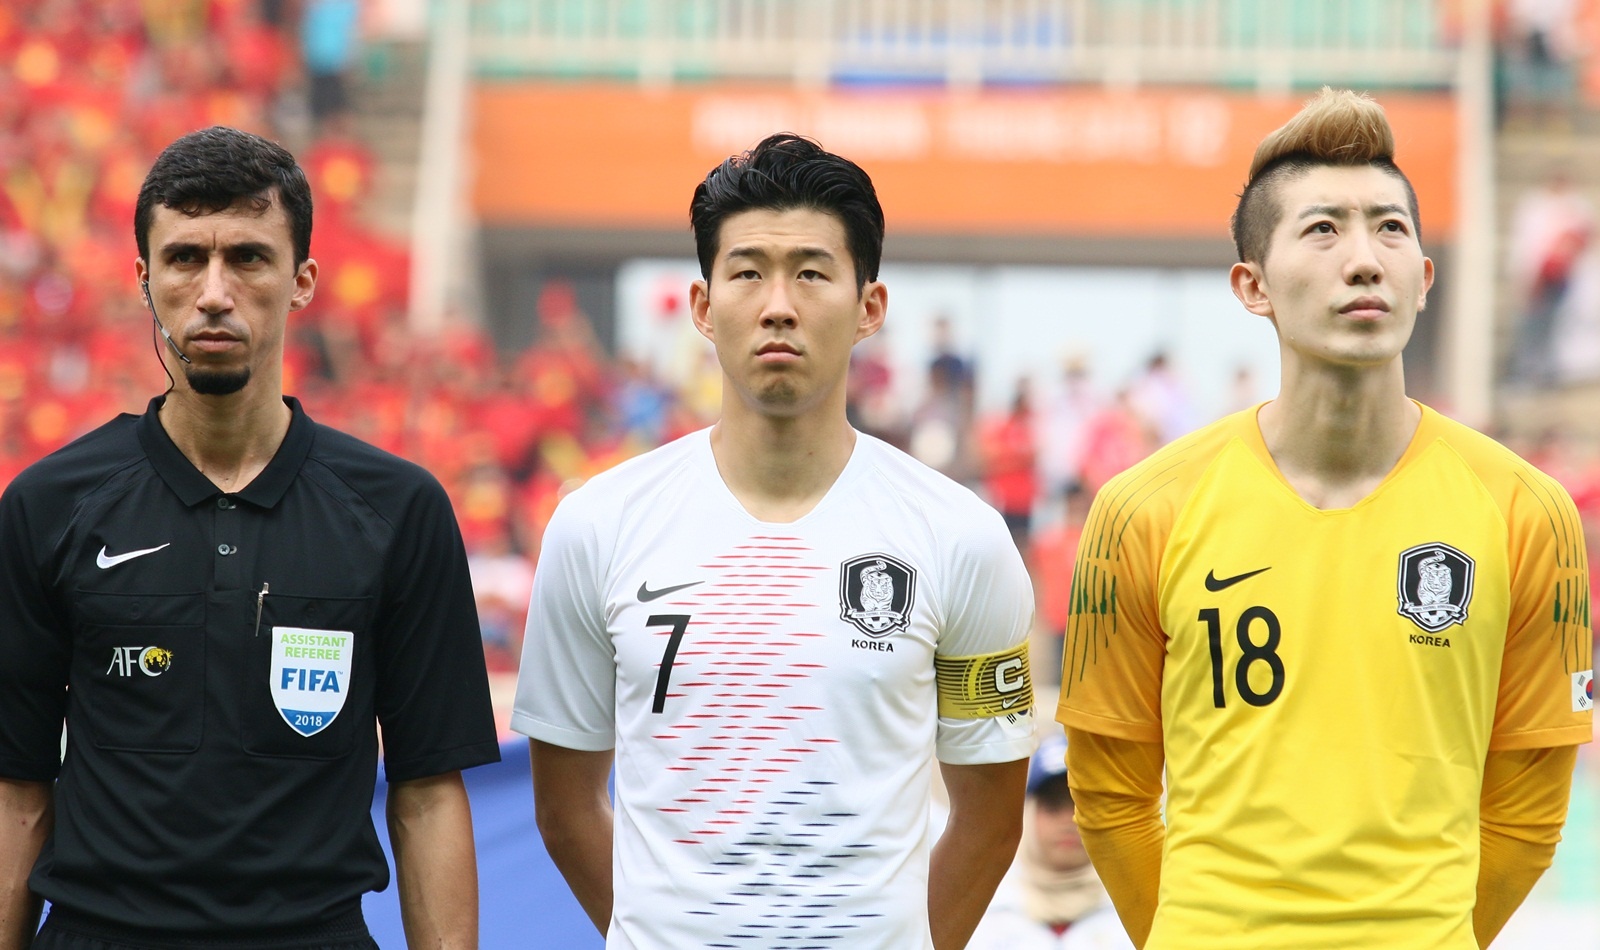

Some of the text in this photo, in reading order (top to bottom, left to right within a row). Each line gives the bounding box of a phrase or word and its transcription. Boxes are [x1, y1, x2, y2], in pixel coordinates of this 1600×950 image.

[280, 633, 347, 647] ASSISTANT
[851, 639, 894, 653] KOREA
[1409, 634, 1451, 648] KOREA
[106, 645, 163, 677] AFC
[285, 646, 340, 660] REFEREE
[1198, 605, 1286, 708] 18
[646, 614, 692, 714] 7
[281, 667, 340, 693] FIFA
[995, 656, 1024, 694] C
[295, 714, 323, 727] 2018
